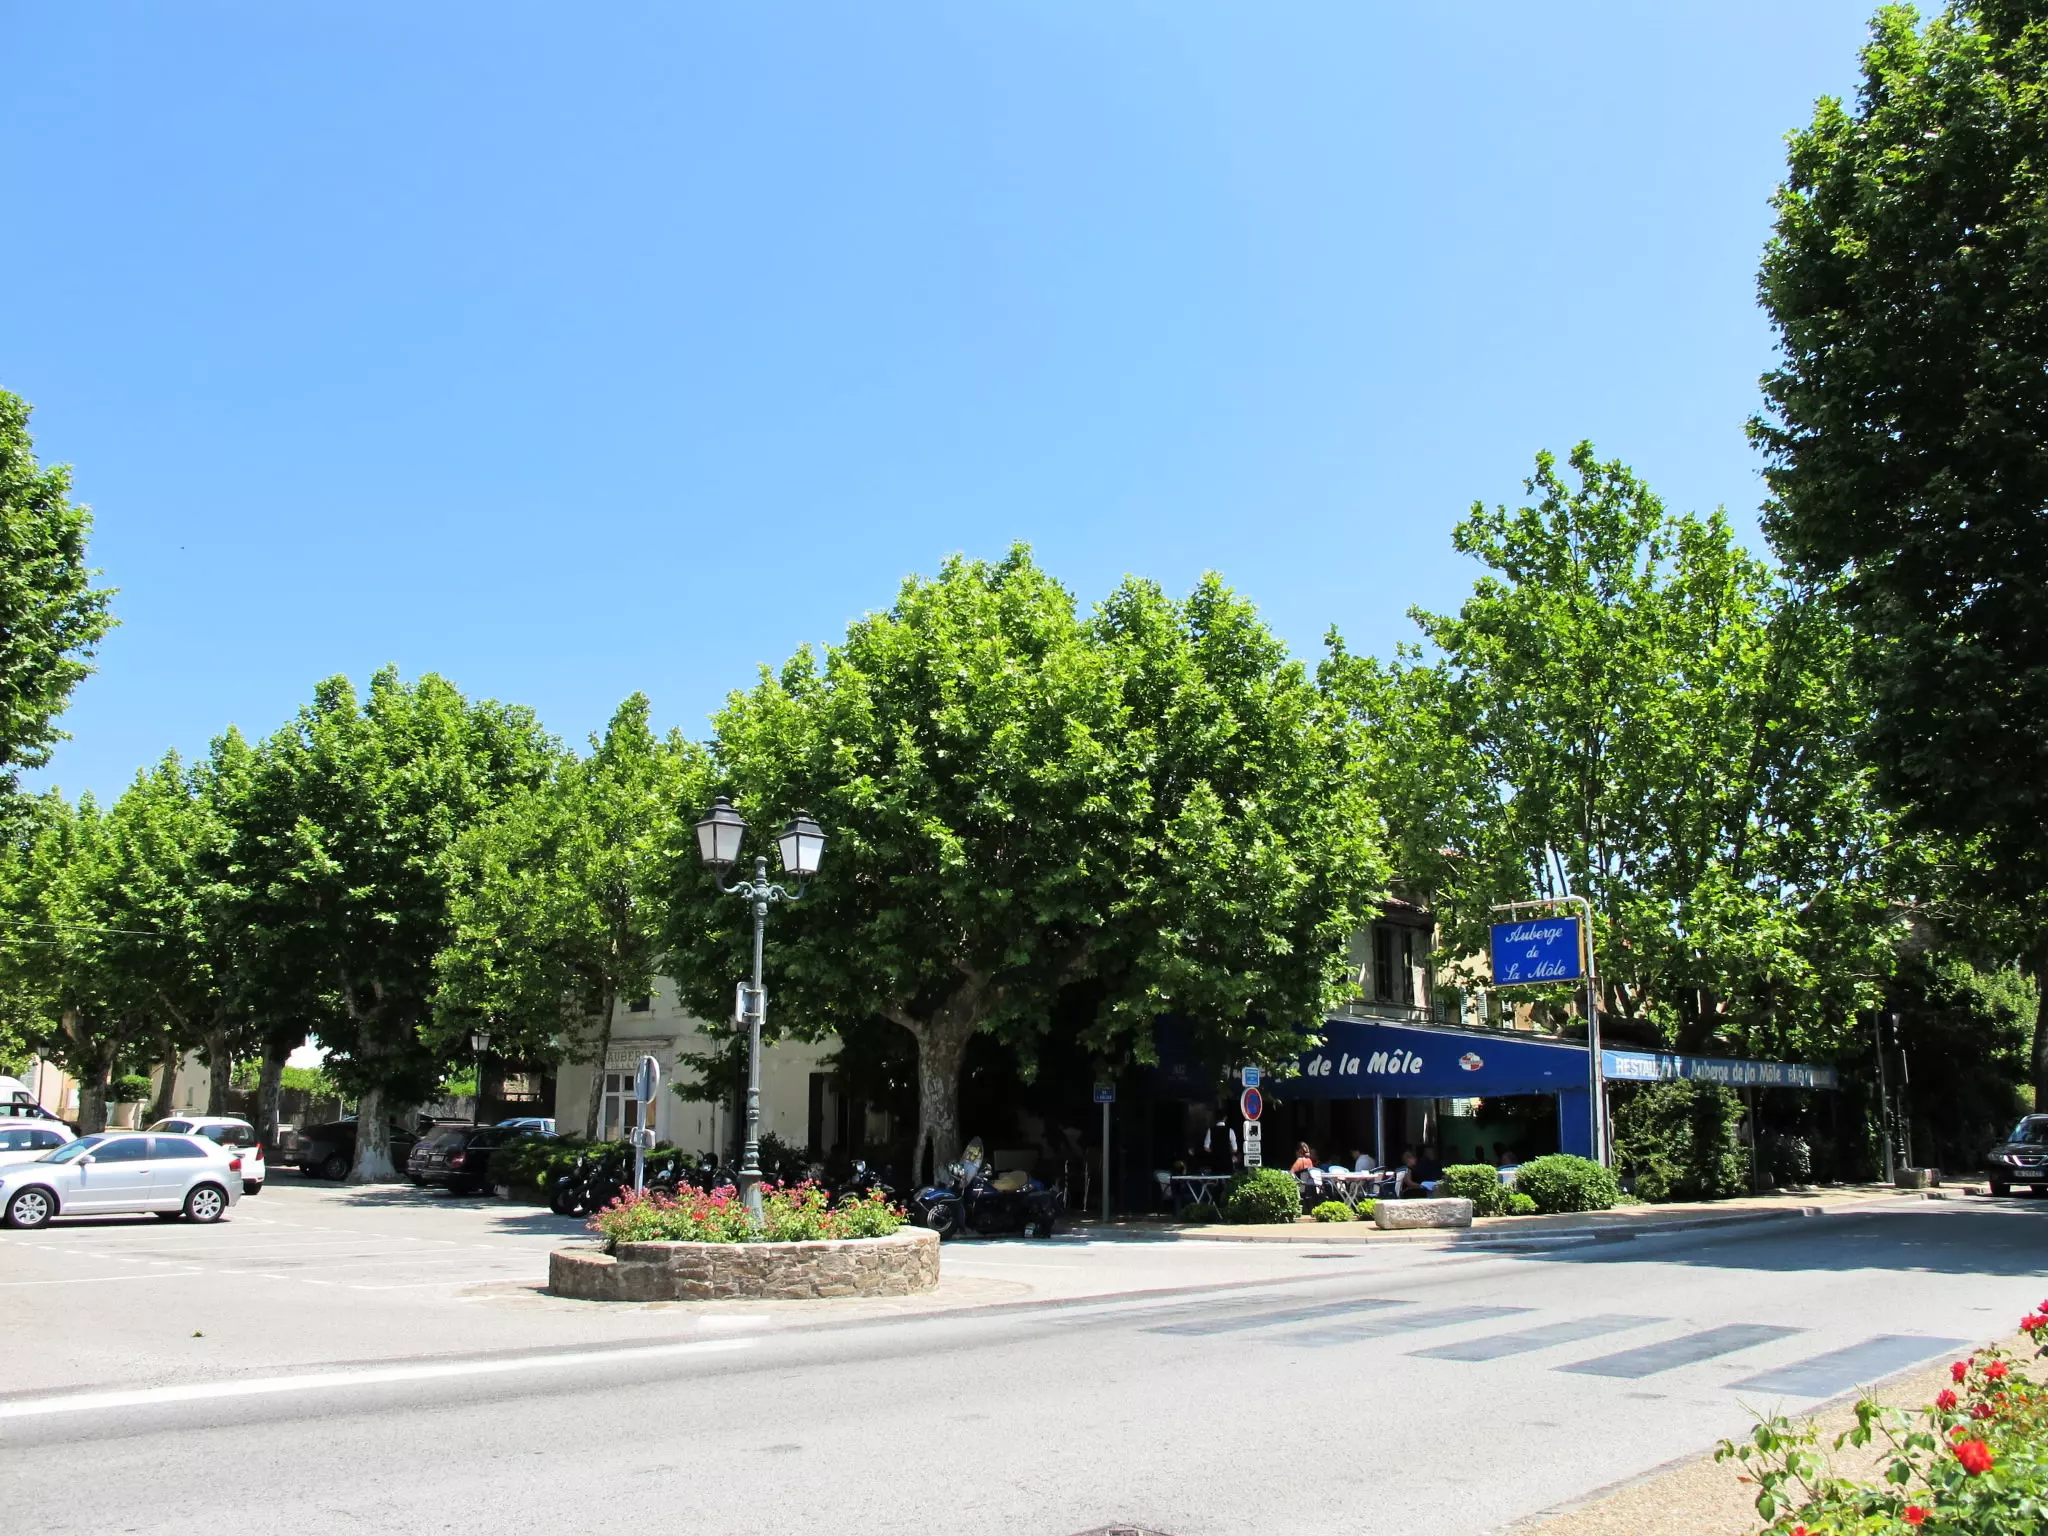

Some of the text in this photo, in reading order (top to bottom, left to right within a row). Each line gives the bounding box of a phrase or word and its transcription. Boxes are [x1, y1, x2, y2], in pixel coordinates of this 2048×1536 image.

[1505, 923, 1563, 945] Auberge
[1526, 945, 1540, 958] de
[1503, 960, 1566, 981] La Môle
[1308, 1054, 1332, 1077] de
[1339, 1053, 1361, 1076] la
[1367, 1048, 1423, 1075] Môle
